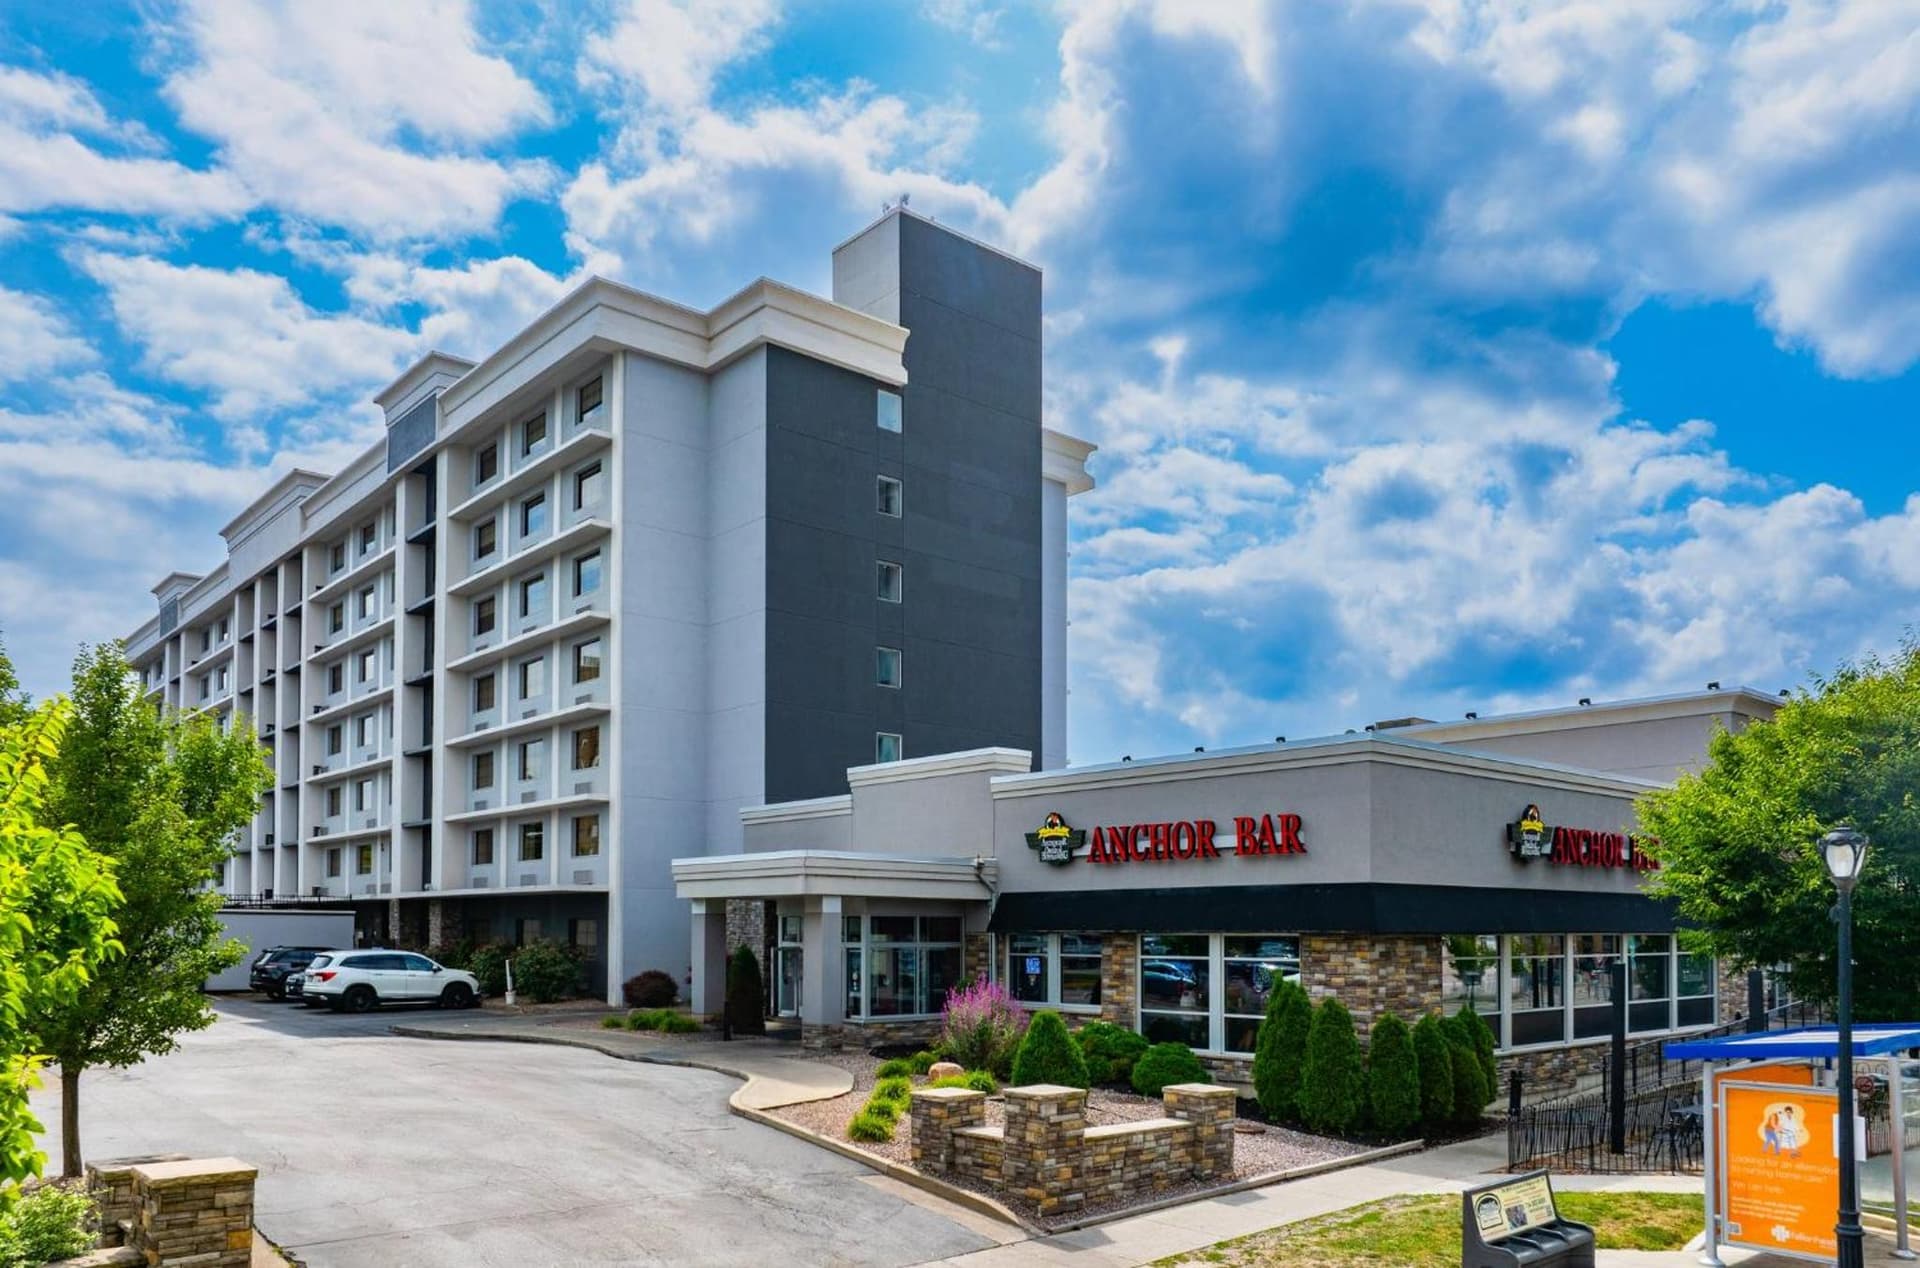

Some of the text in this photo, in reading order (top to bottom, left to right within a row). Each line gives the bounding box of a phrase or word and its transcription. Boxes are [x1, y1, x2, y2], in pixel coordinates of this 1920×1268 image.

[1087, 819, 1221, 863] ANCHOR
[1233, 813, 1308, 856] BAR
[1552, 827, 1624, 867] ANCHOR
